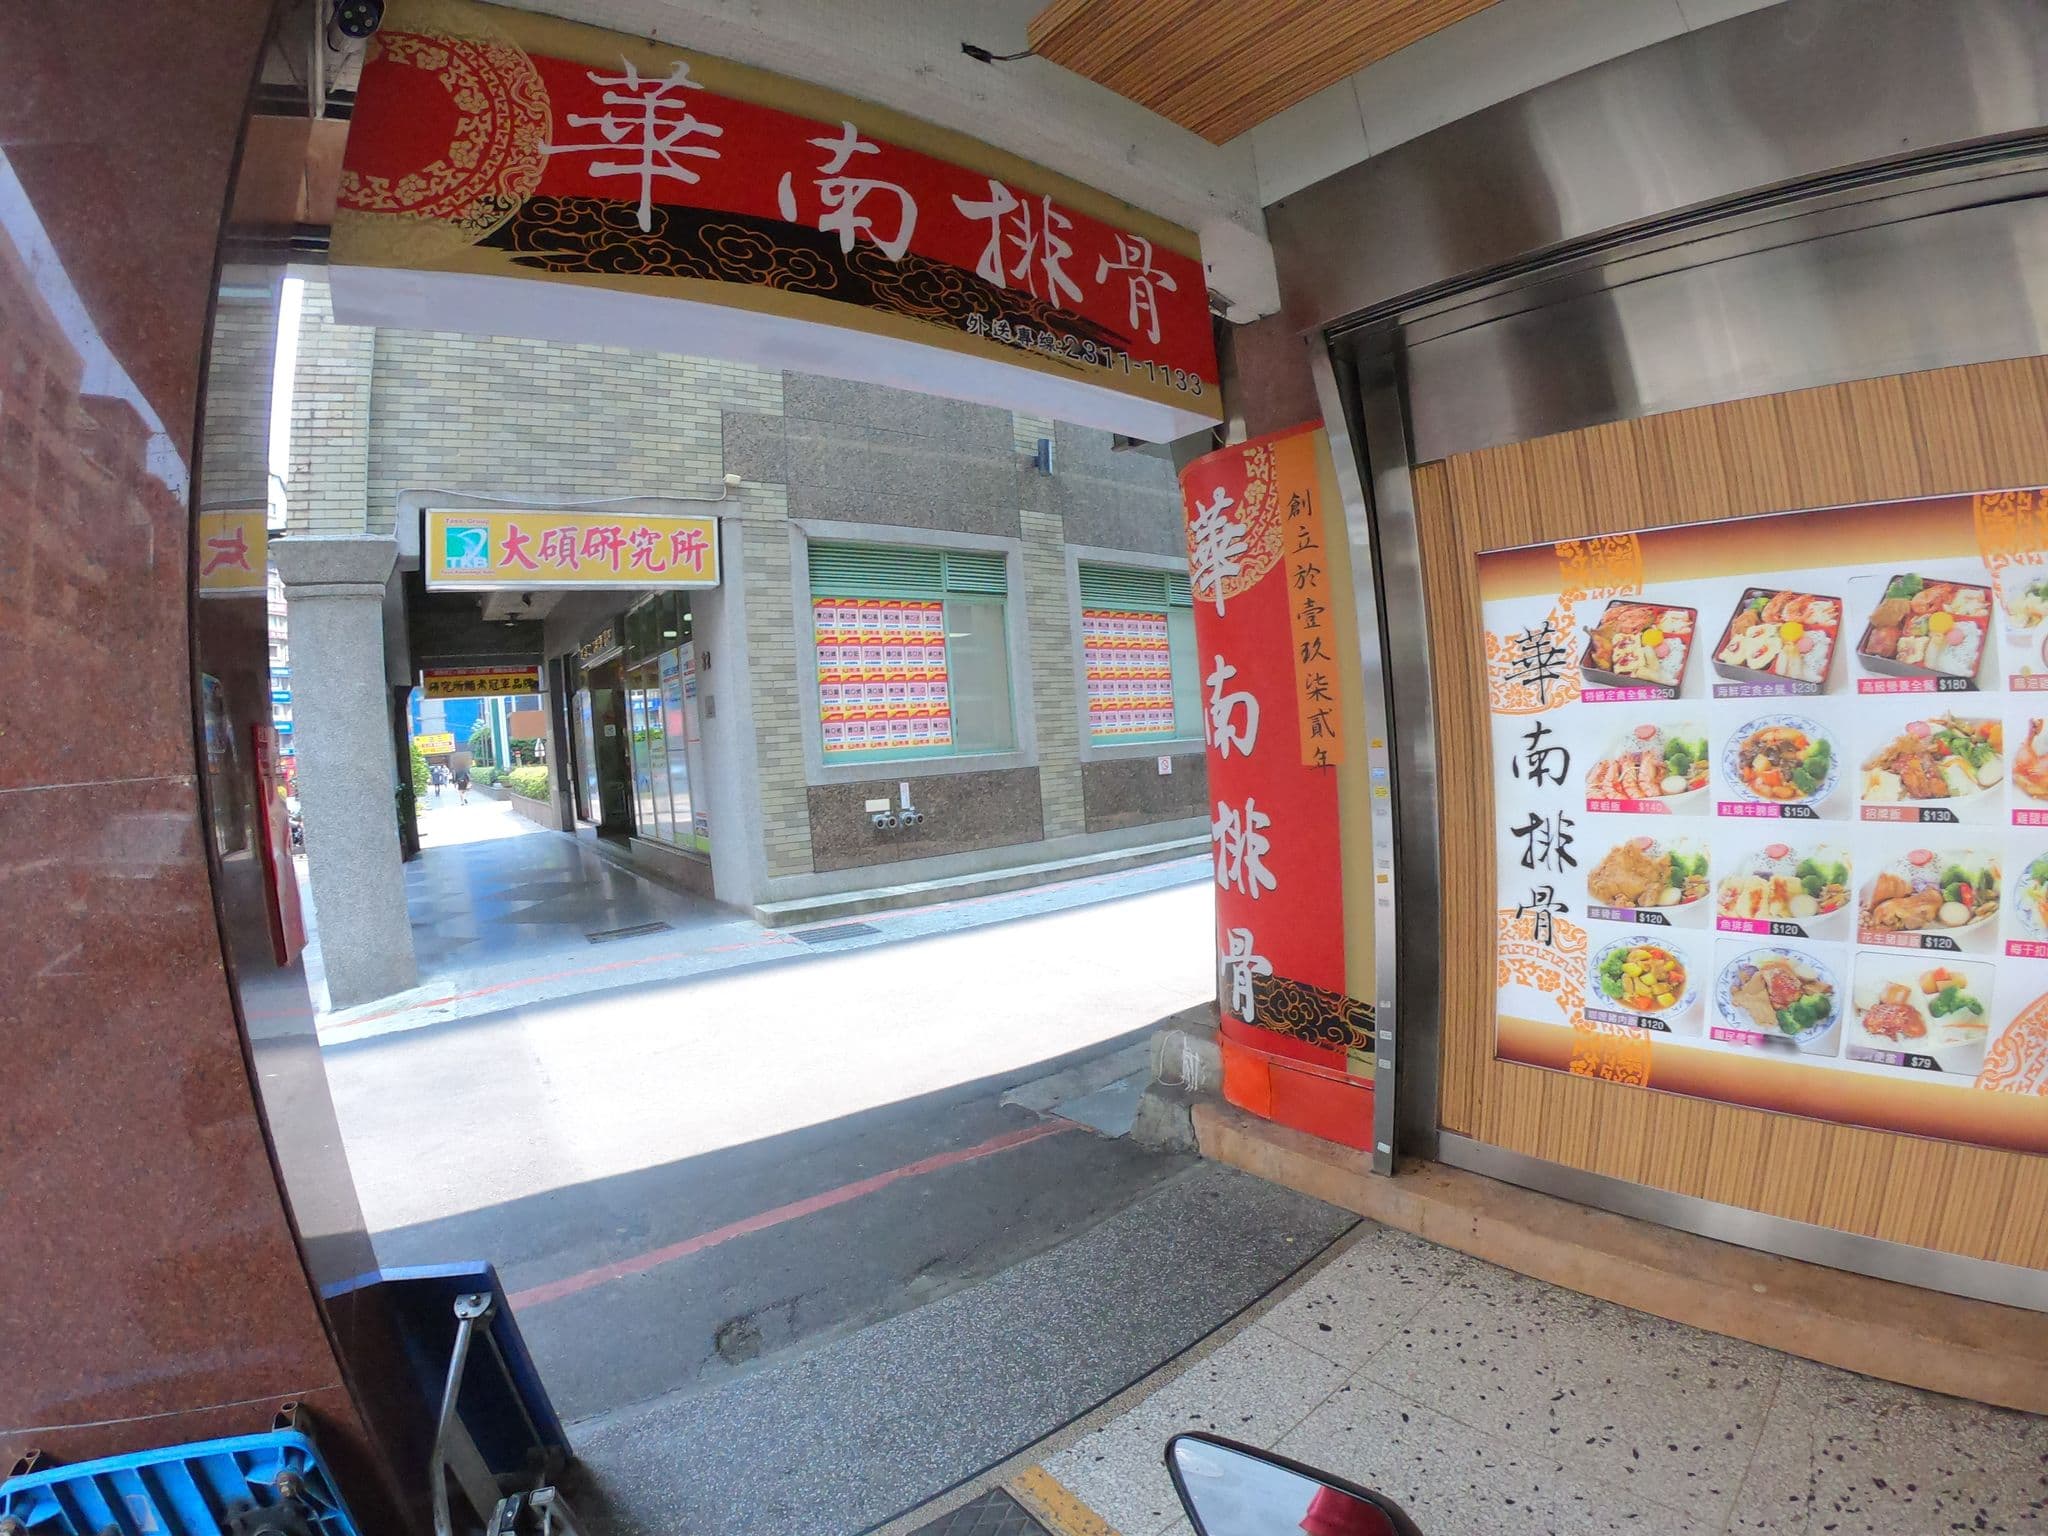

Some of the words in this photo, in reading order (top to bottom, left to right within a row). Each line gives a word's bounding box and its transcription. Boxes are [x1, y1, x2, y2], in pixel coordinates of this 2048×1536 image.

[537, 54, 1177, 343] 華南排骨
[498, 524, 710, 574] 大碩研究所
[1282, 488, 1337, 777] 創立於壹玖柒貳年
[1939, 679, 1967, 690] $180
[1651, 688, 1675, 699] $250
[1189, 486, 1277, 1024] 華南排骨
[1504, 620, 1578, 947] 華南排骨
[1784, 806, 1810, 817] $150
[1923, 809, 1952, 822] $130
[1639, 912, 1663, 924] $120
[1772, 922, 1799, 935] $120
[1925, 936, 1953, 949] $120
[1641, 1017, 1665, 1030] $120
[1911, 1056, 1931, 1069] $79
